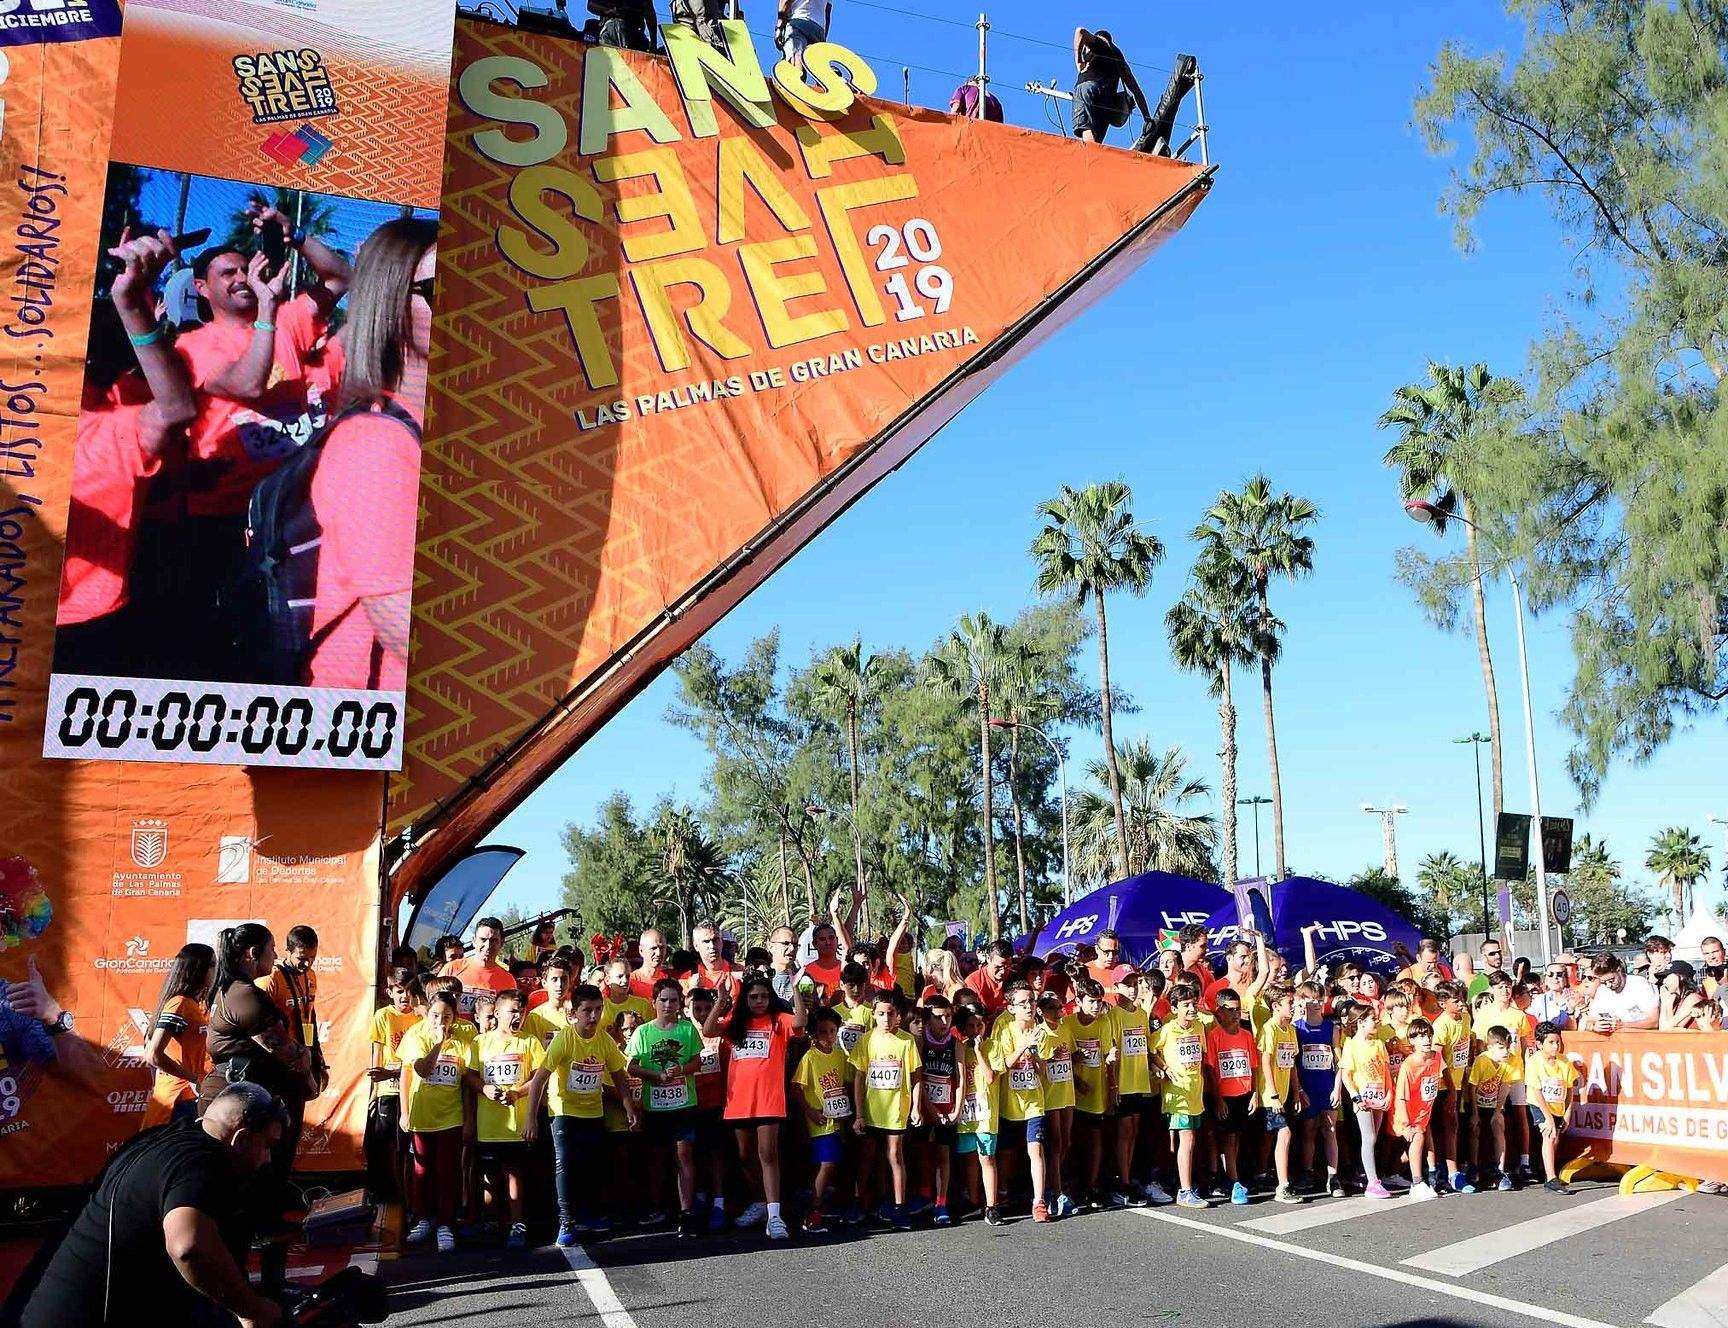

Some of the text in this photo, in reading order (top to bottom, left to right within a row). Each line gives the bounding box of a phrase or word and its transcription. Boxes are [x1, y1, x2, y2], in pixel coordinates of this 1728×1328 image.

[866, 217, 943, 271] 20
[884, 264, 955, 322] 19
[576, 325, 980, 432] LAS PALMAS DE GRAN CANARIA
[58, 686, 398, 760] 00:00:00.00
[257, 854, 347, 865] Instituto Municipal
[112, 872, 182, 881] Ayuntamiento
[255, 866, 317, 875] de Deportes
[112, 880, 181, 888] de Las Palmas
[112, 888, 181, 896] de Gran Canaria
[1556, 902, 1568, 913] 40
[1054, 913, 1099, 940] HPS
[1313, 920, 1388, 942] HPS
[429, 1064, 458, 1077] 190
[487, 1063, 520, 1077] 2187
[1221, 1059, 1247, 1071] 9209
[575, 1073, 599, 1085] 401
[870, 1069, 899, 1081] 4407
[653, 1087, 683, 1100] 9438
[1574, 1110, 1604, 1129] LAS
[1608, 1113, 1679, 1136] PALMAS
[1686, 1117, 1709, 1139] DE
